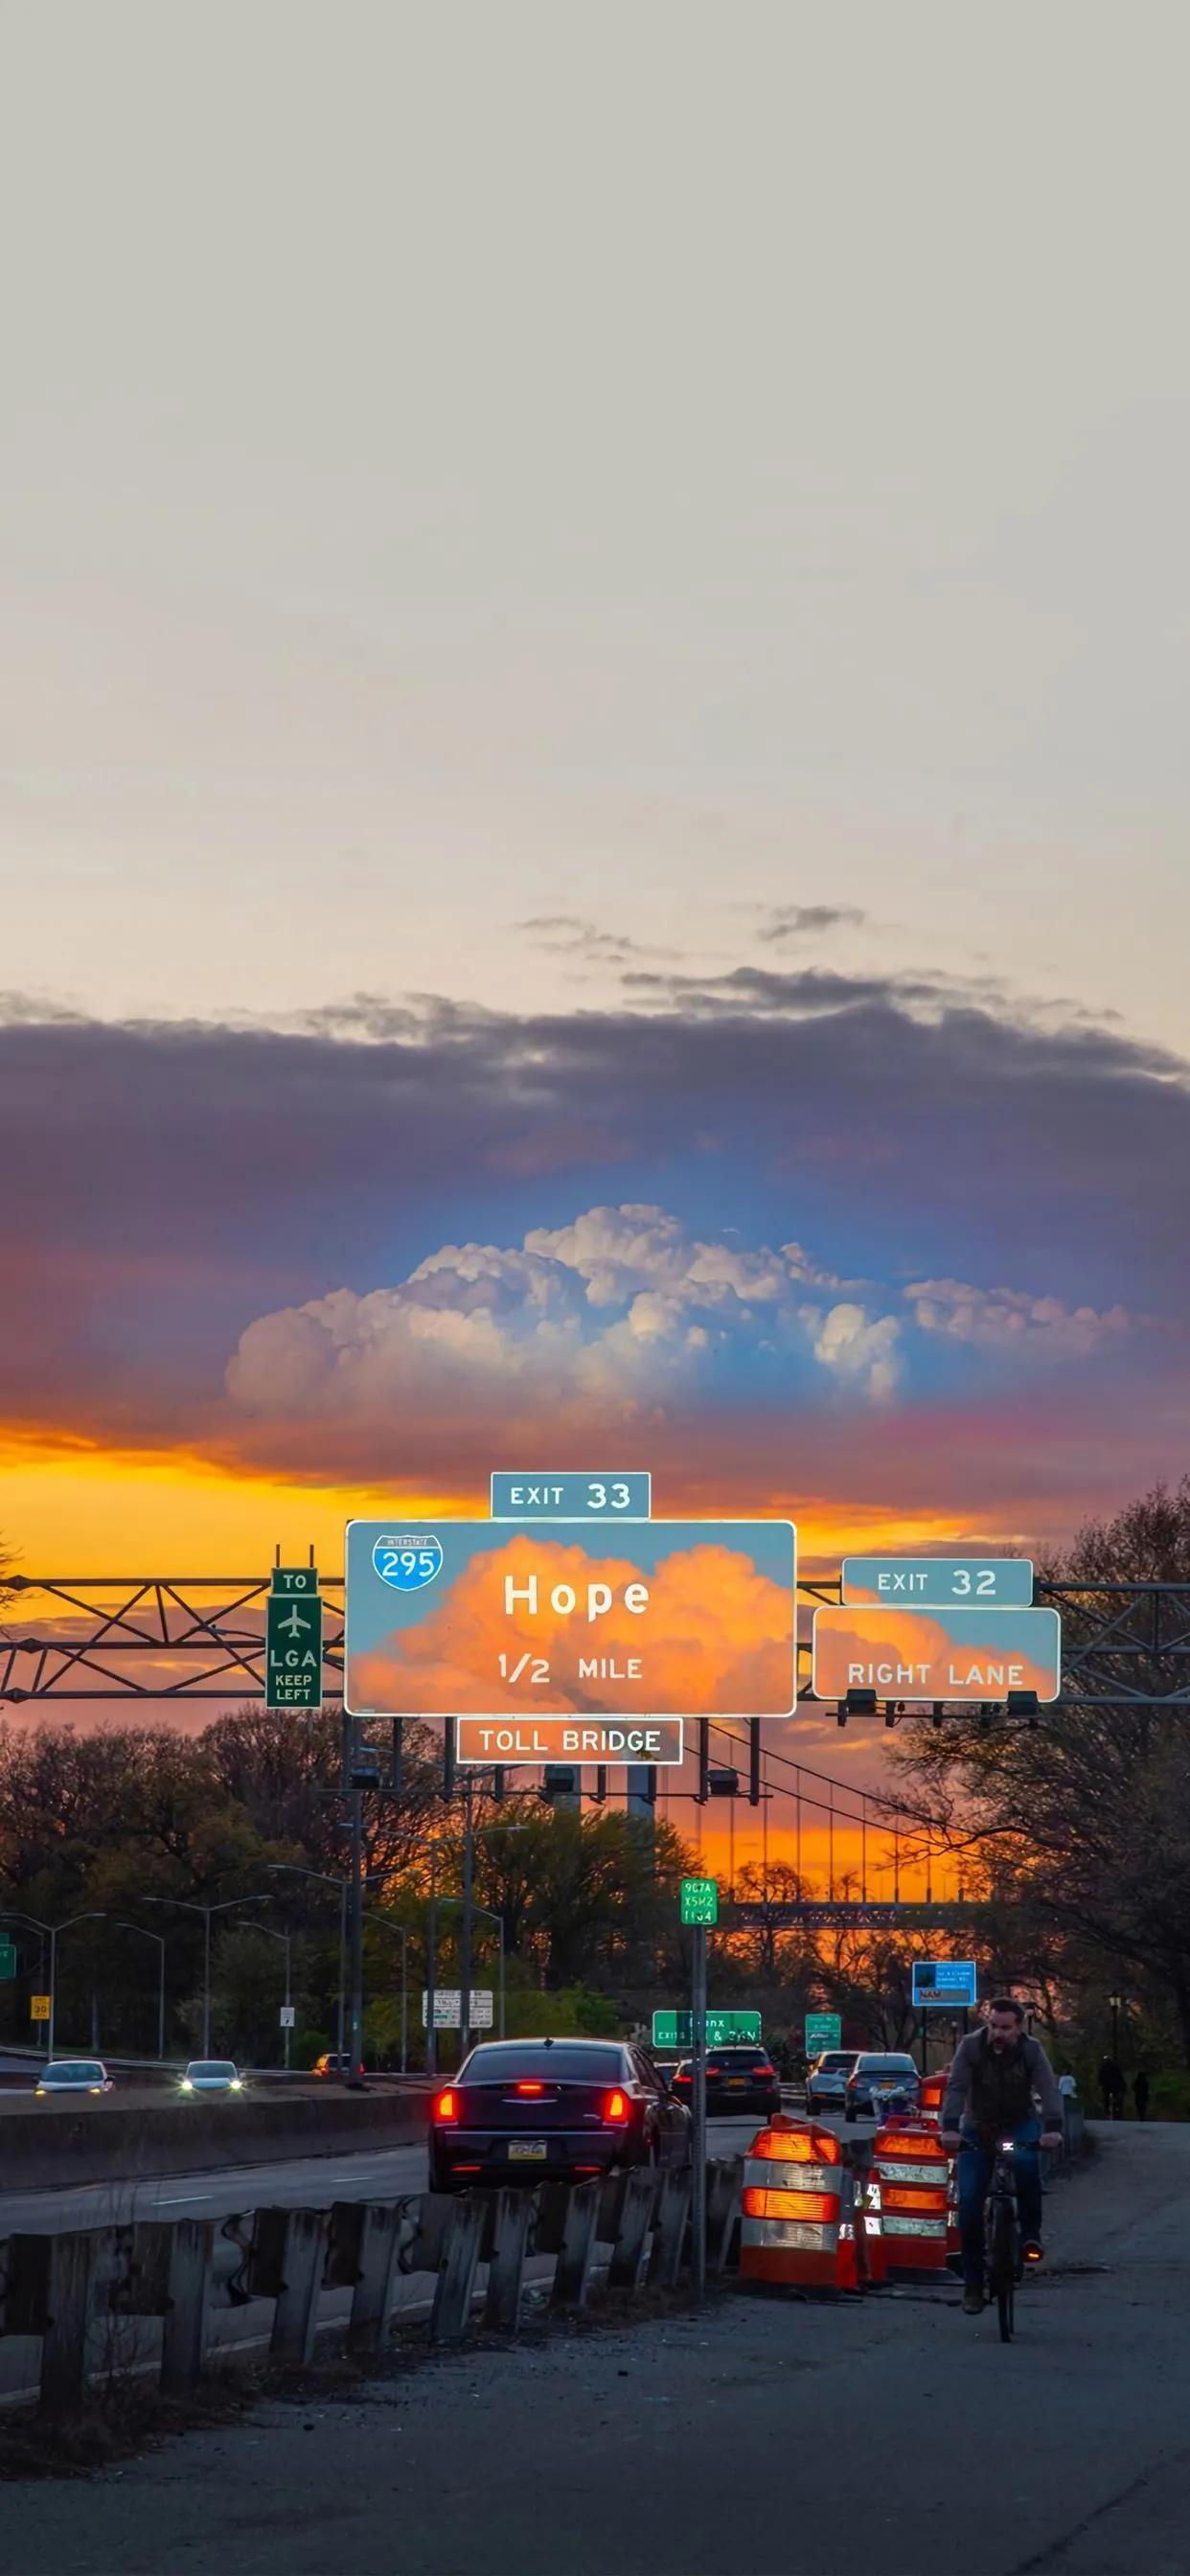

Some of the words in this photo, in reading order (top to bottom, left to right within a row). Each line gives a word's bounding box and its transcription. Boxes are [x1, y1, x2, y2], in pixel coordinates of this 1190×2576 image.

[511, 1487, 563, 1505] EXIT
[586, 1484, 630, 1508] 33
[382, 1552, 435, 1576] 295
[283, 1575, 307, 1589] TO
[878, 1574, 928, 1591] EXIT
[951, 1570, 996, 1596] 32
[504, 1575, 650, 1622] Hope
[270, 1649, 317, 1668] LGA
[498, 1653, 551, 1683] 1/2
[579, 1658, 643, 1679] MILE
[275, 1674, 312, 1687] KEEP
[848, 1663, 931, 1685] RIGHT
[949, 1664, 1023, 1686] LANE
[276, 1689, 310, 1700] LEFT
[479, 1730, 549, 1751] TOLL
[562, 1730, 661, 1752] BRIDGE
[685, 1882, 711, 1894] 907A
